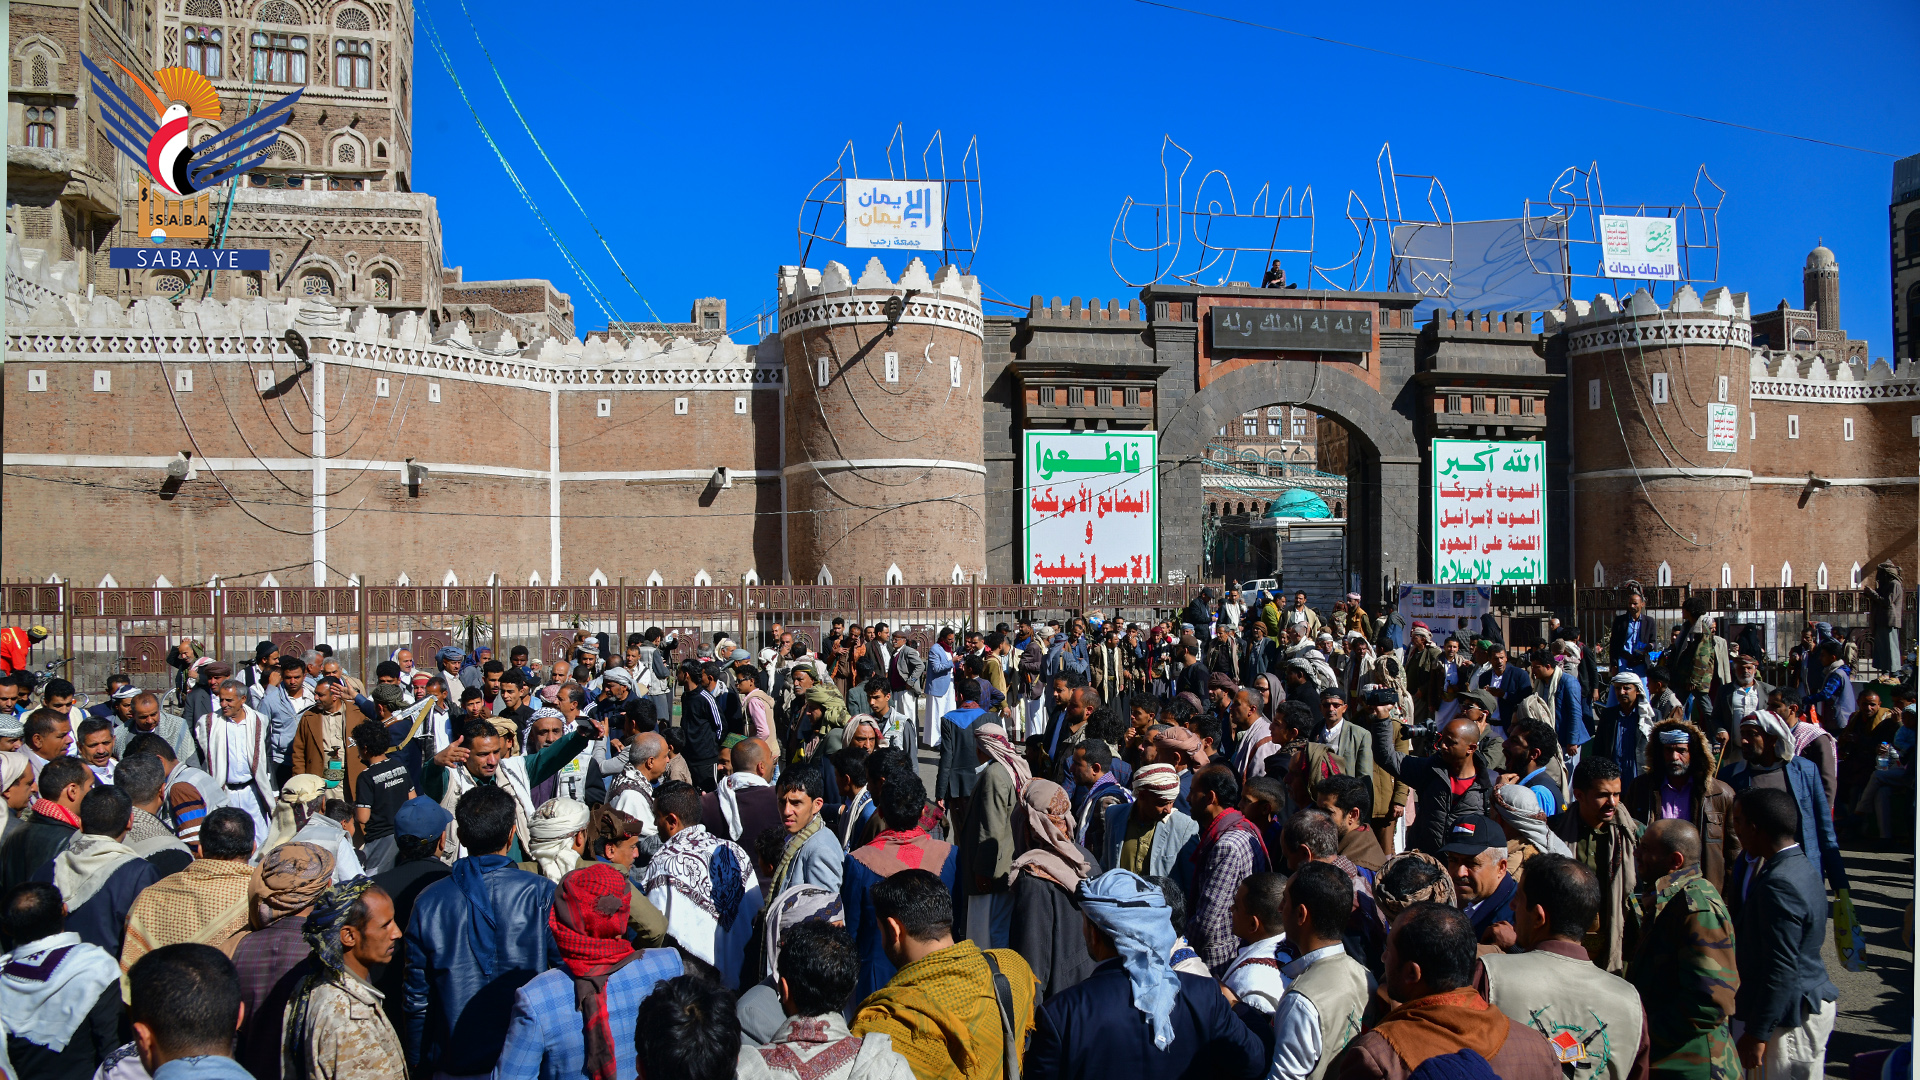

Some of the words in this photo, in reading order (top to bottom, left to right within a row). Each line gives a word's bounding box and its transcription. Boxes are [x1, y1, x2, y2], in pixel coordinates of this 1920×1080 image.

[869, 238, 891, 248] رجب
[894, 237, 921, 248] جمعة
[1259, 312, 1303, 332] الملك
[1035, 440, 1140, 481] قاطعوا
[1438, 444, 1500, 479] أكبر
[1031, 482, 1092, 519] الأمريكية
[1440, 478, 1493, 502] لأمريكا
[1497, 483, 1539, 502] الموت
[1097, 487, 1150, 519] البضائع
[1440, 507, 1493, 529] لإسرائيل
[1497, 509, 1540, 528] الموت
[1085, 520, 1093, 545] و
[1507, 534, 1540, 551] اللعنة
[1440, 534, 1477, 555] اليهود
[1482, 534, 1503, 555] على
[1495, 556, 1541, 585] النصر
[391, 765, 408, 778] STAR
